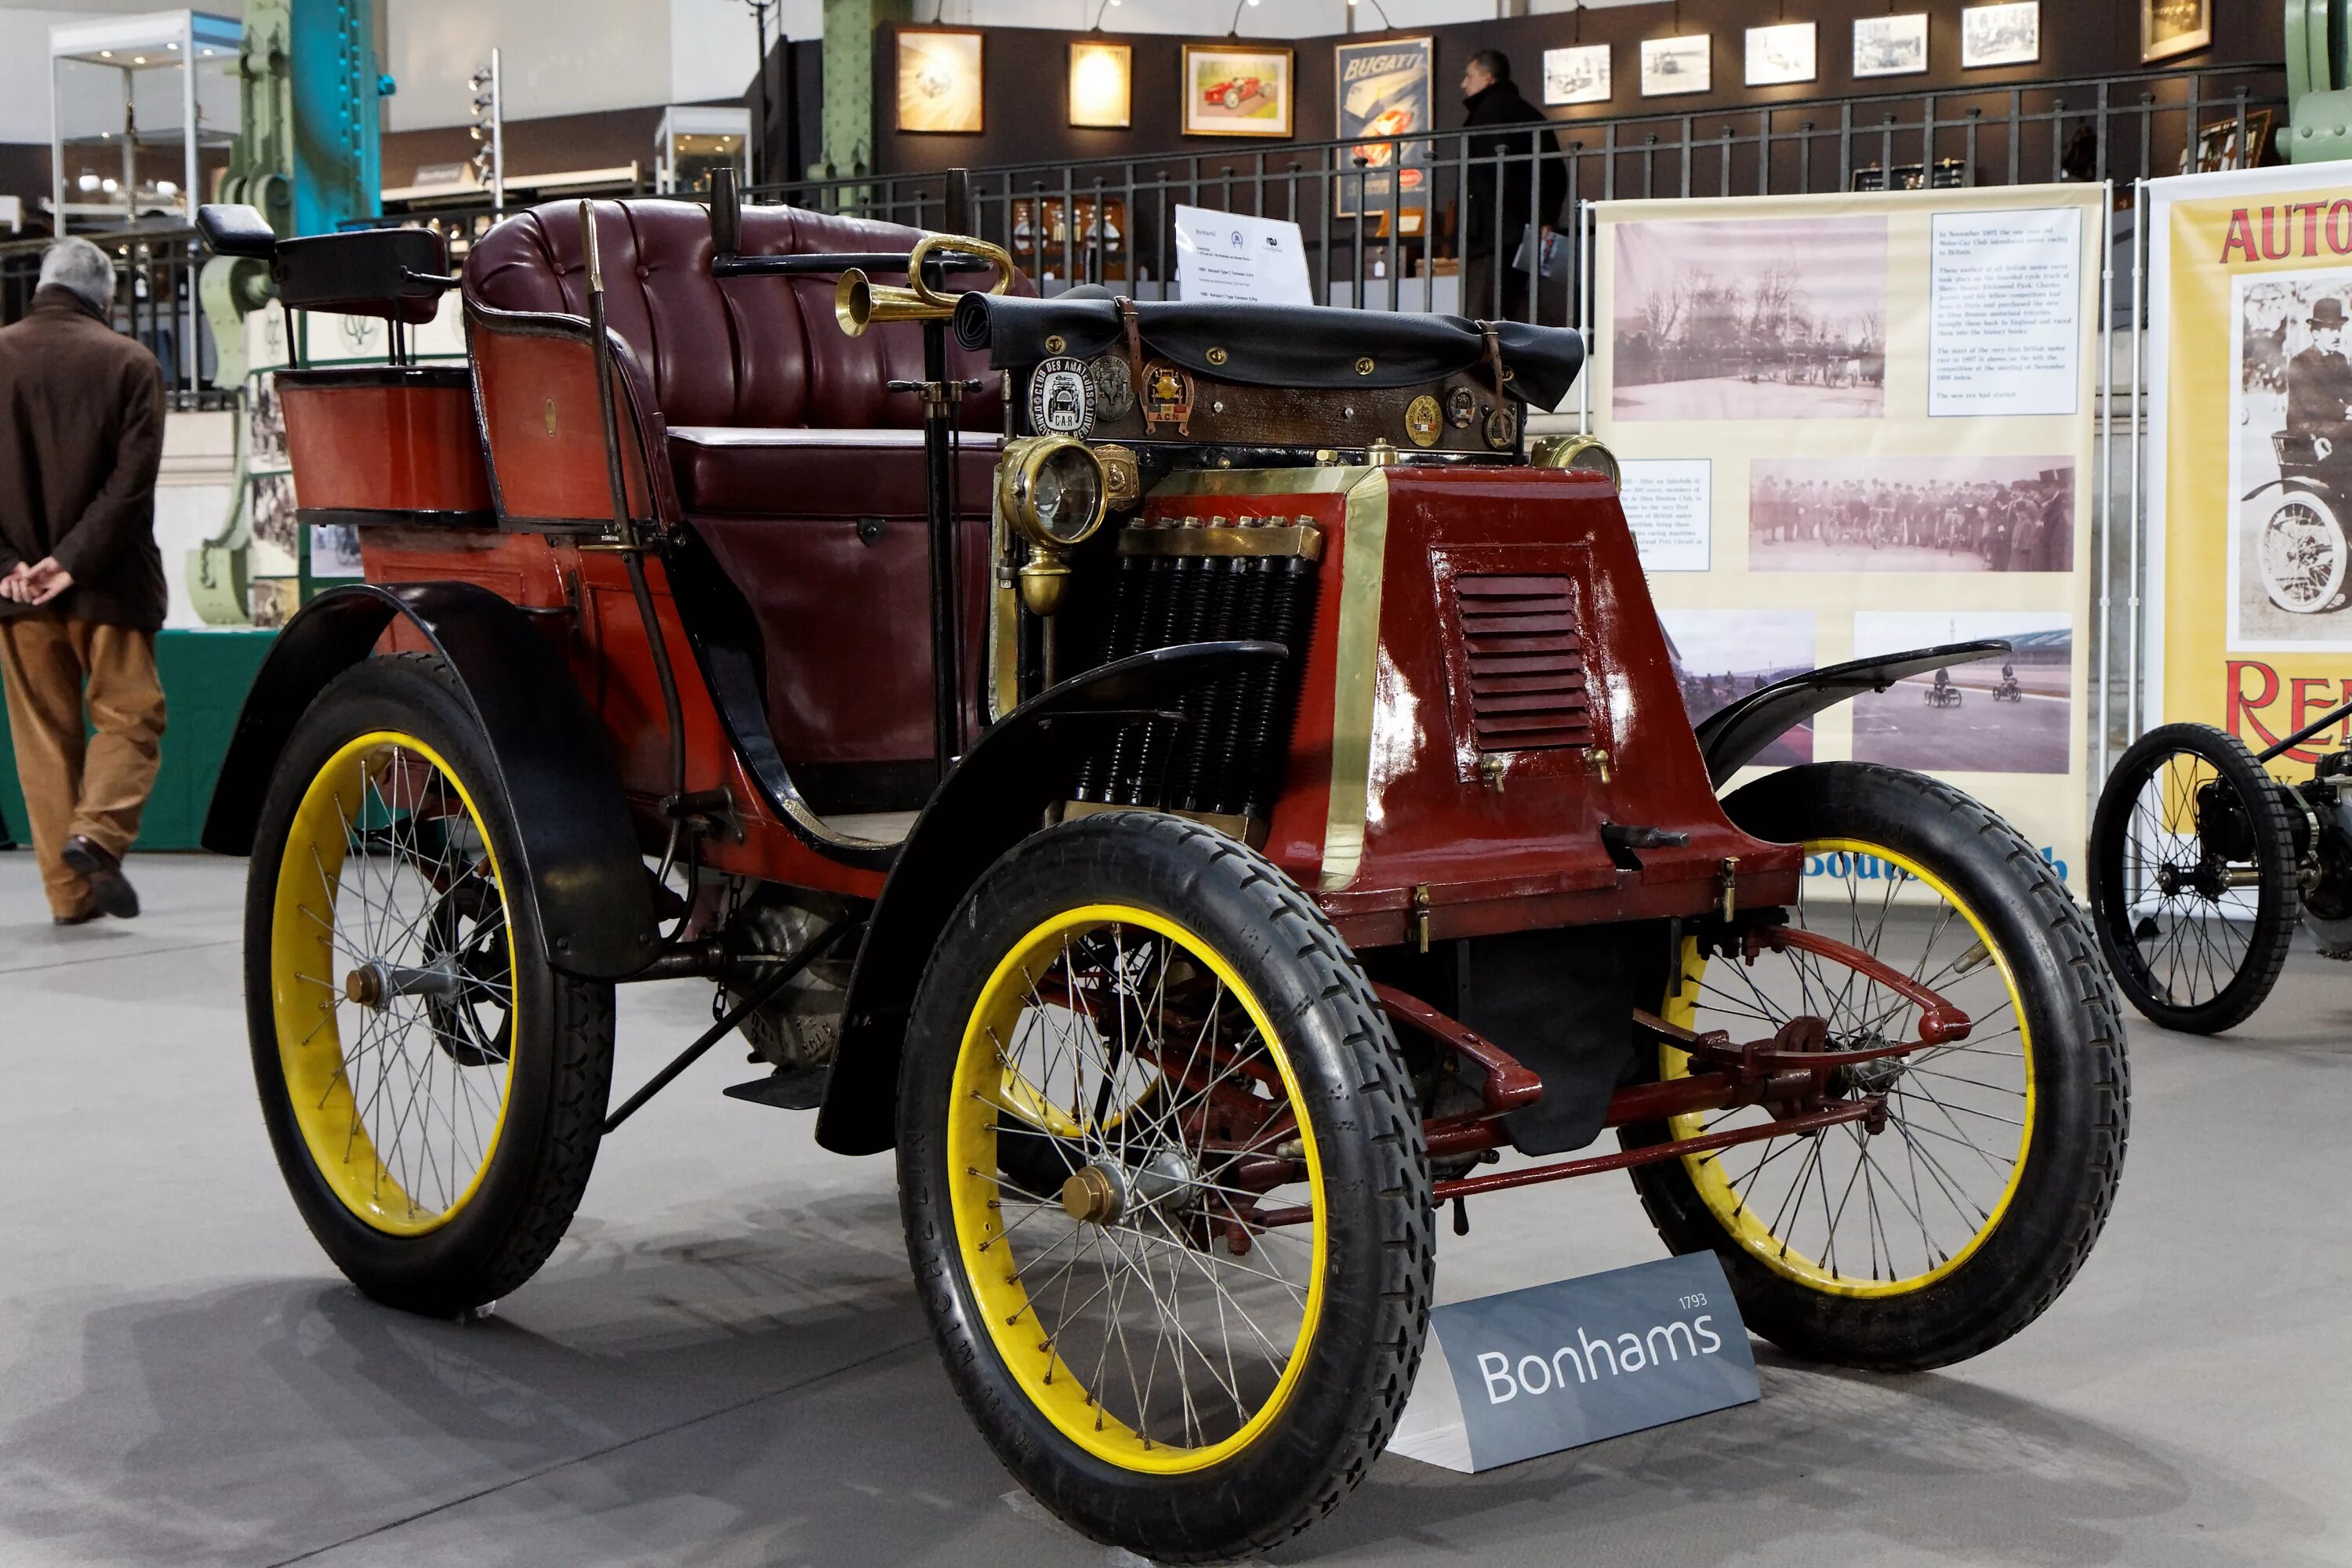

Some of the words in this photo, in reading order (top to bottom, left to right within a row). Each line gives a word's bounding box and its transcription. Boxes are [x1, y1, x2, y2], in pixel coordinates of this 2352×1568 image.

[1344, 53, 1424, 82] BUGATTI
[1035, 369, 1046, 394] CLUB
[1046, 360, 1061, 372] DES
[1065, 361, 1094, 397] AMATEURS
[1679, 1293, 1708, 1310] 1793
[1477, 1315, 1722, 1405] Bonhams
